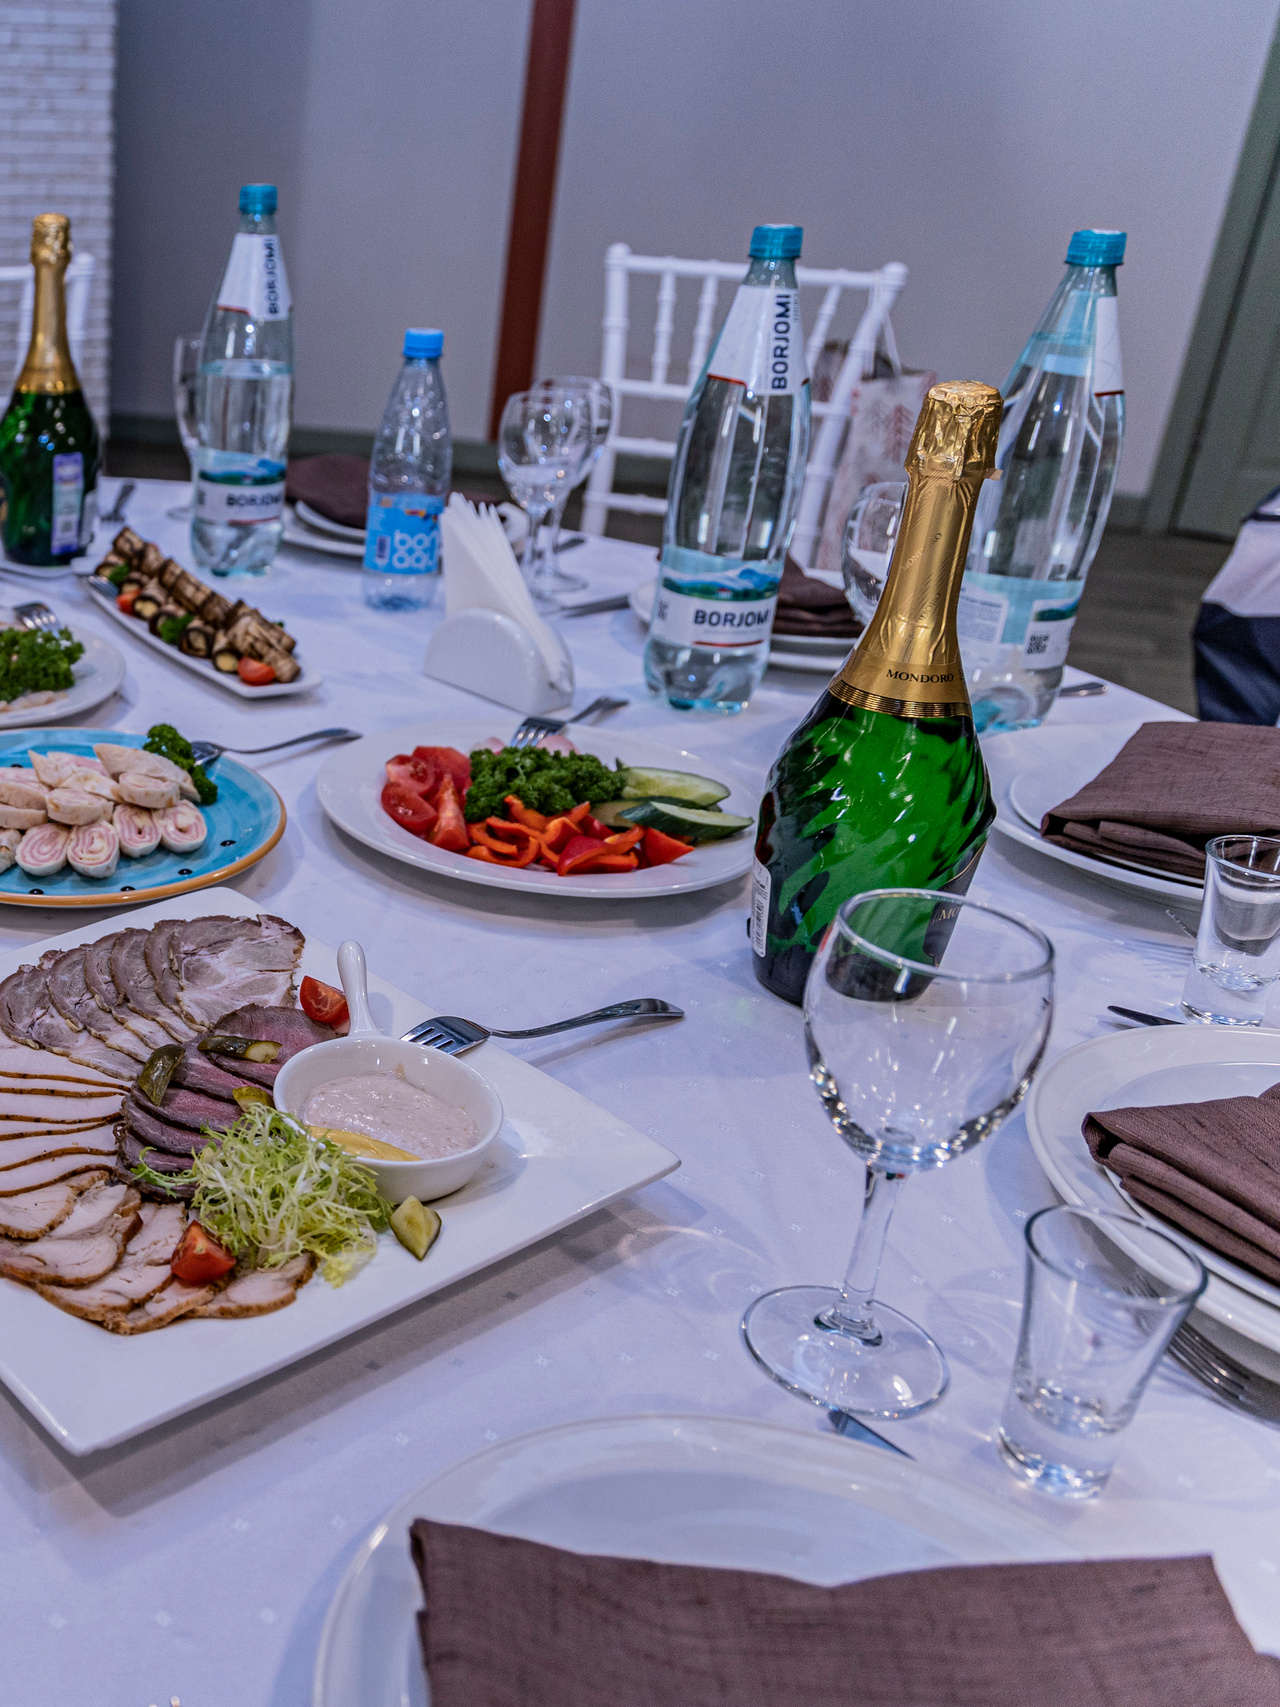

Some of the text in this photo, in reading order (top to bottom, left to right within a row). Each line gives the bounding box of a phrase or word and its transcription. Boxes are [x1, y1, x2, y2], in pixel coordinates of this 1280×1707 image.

[263, 238, 278, 314] BORJOMI
[772, 294, 792, 390] BORJOMI
[226, 492, 282, 506] BORJOM
[694, 609, 770, 627] BORJOM
[886, 669, 955, 684] MONDORO
